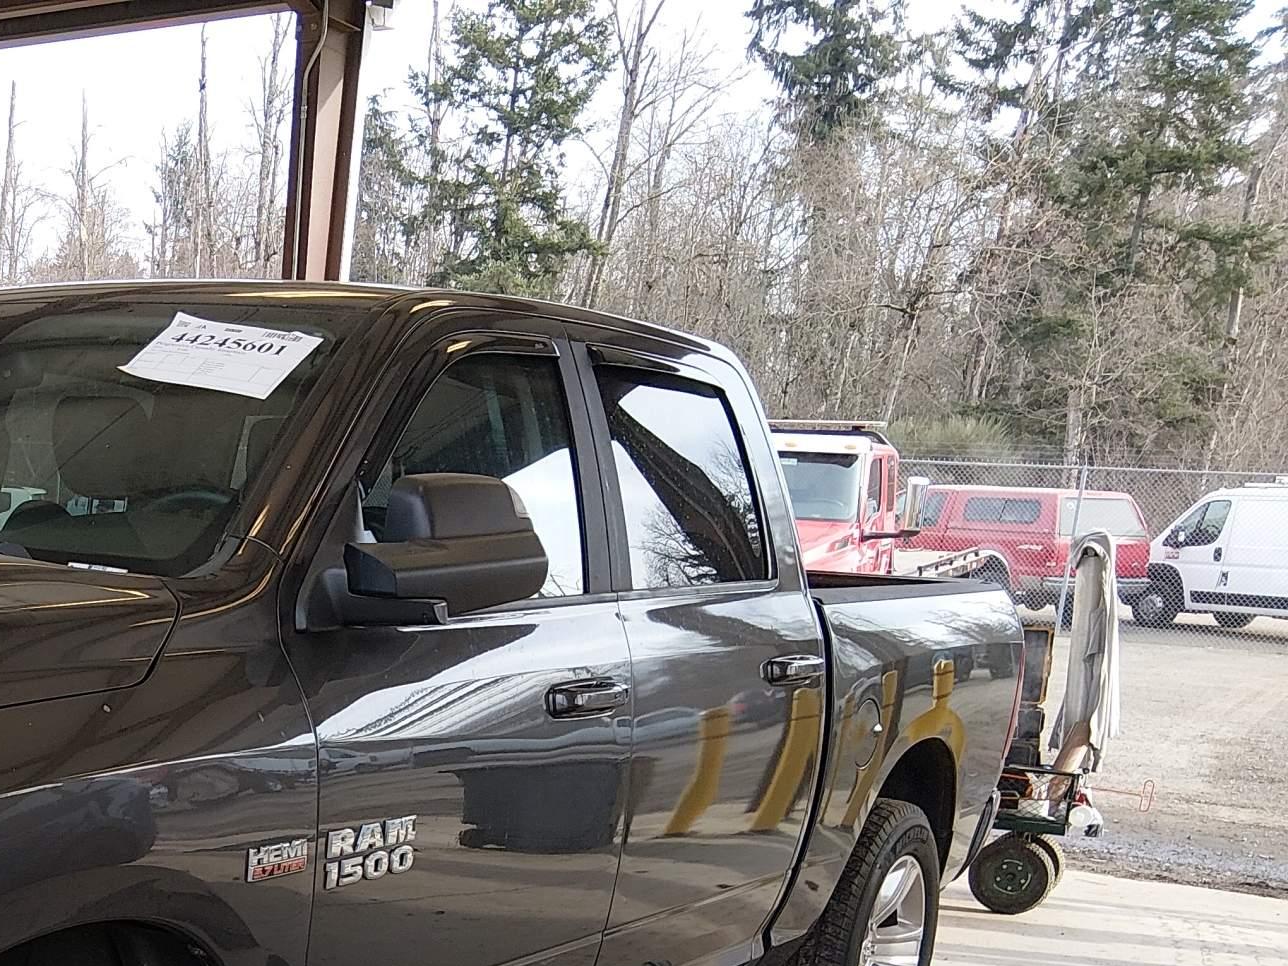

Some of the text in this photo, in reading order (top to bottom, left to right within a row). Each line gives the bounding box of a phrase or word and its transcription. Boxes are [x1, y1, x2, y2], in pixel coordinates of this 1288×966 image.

[171, 331, 289, 357] 44245601
[326, 815, 418, 859] RAM
[248, 839, 308, 867] HEMI
[252, 861, 307, 880] 5.7 LITER
[325, 845, 416, 891] 1500
